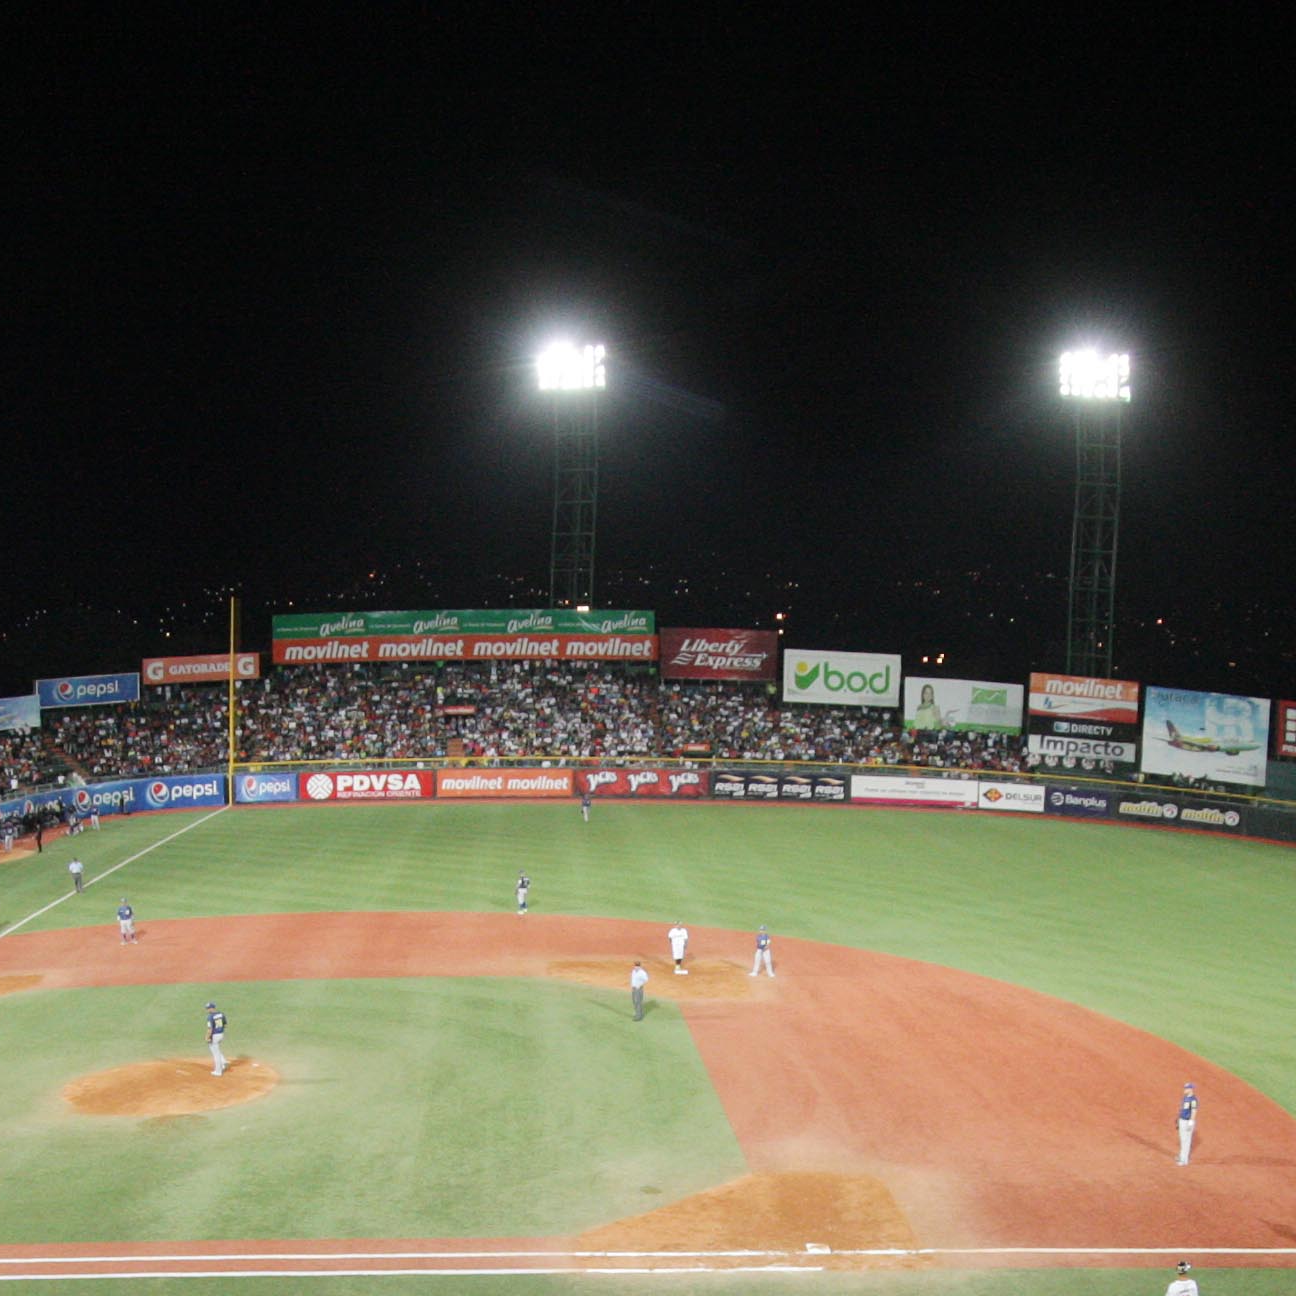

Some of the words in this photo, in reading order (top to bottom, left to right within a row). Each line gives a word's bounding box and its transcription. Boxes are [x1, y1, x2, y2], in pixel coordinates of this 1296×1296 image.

[285, 640, 370, 661] movilnet
[378, 639, 464, 660] movilnet
[473, 638, 559, 656] movilnet
[566, 639, 652, 657] movilnet
[679, 638, 744, 656] Liberty
[693, 652, 762, 669] Express
[77, 680, 119, 697] pepsi
[1045, 679, 1123, 698] movilnet
[1071, 722, 1114, 736] DIRECTV
[1039, 734, 1124, 759] Impacto
[172, 780, 220, 801] pepsi
[259, 779, 291, 795] pepsi
[337, 773, 422, 791] PDVSA
[442, 775, 503, 791] movilnet
[507, 776, 569, 791] movilnet
[93, 786, 134, 807] pepsi
